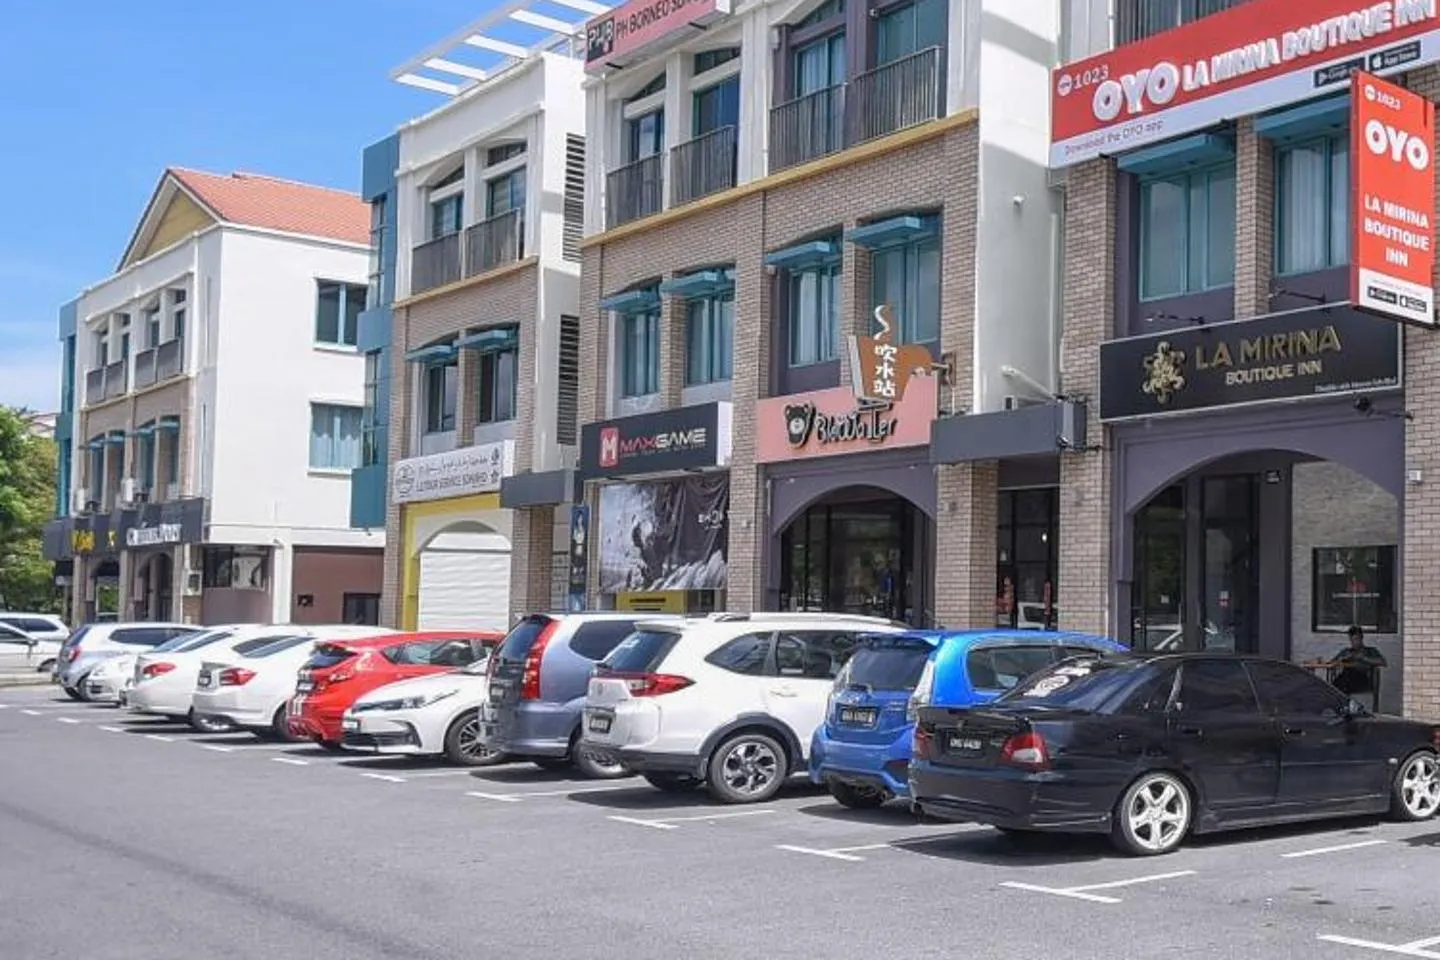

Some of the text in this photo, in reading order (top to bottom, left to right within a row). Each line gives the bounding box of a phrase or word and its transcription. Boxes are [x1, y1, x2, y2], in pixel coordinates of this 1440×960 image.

[616, 18, 628, 39] PH
[1092, 60, 1180, 121] OYO
[1183, 60, 1210, 92] LA
[1211, 38, 1281, 83] MIRINA
[1281, 1, 1393, 59] BOUTIQUE
[1365, 119, 1429, 170] OYO
[1364, 193, 1429, 229] LA MIRINA
[1364, 217, 1430, 252] BOUTIQUE
[1386, 247, 1408, 267] INN
[1195, 325, 1342, 370] LA MIRINA
[1225, 363, 1294, 386] BOUTIQUE
[1297, 360, 1322, 376] INN
